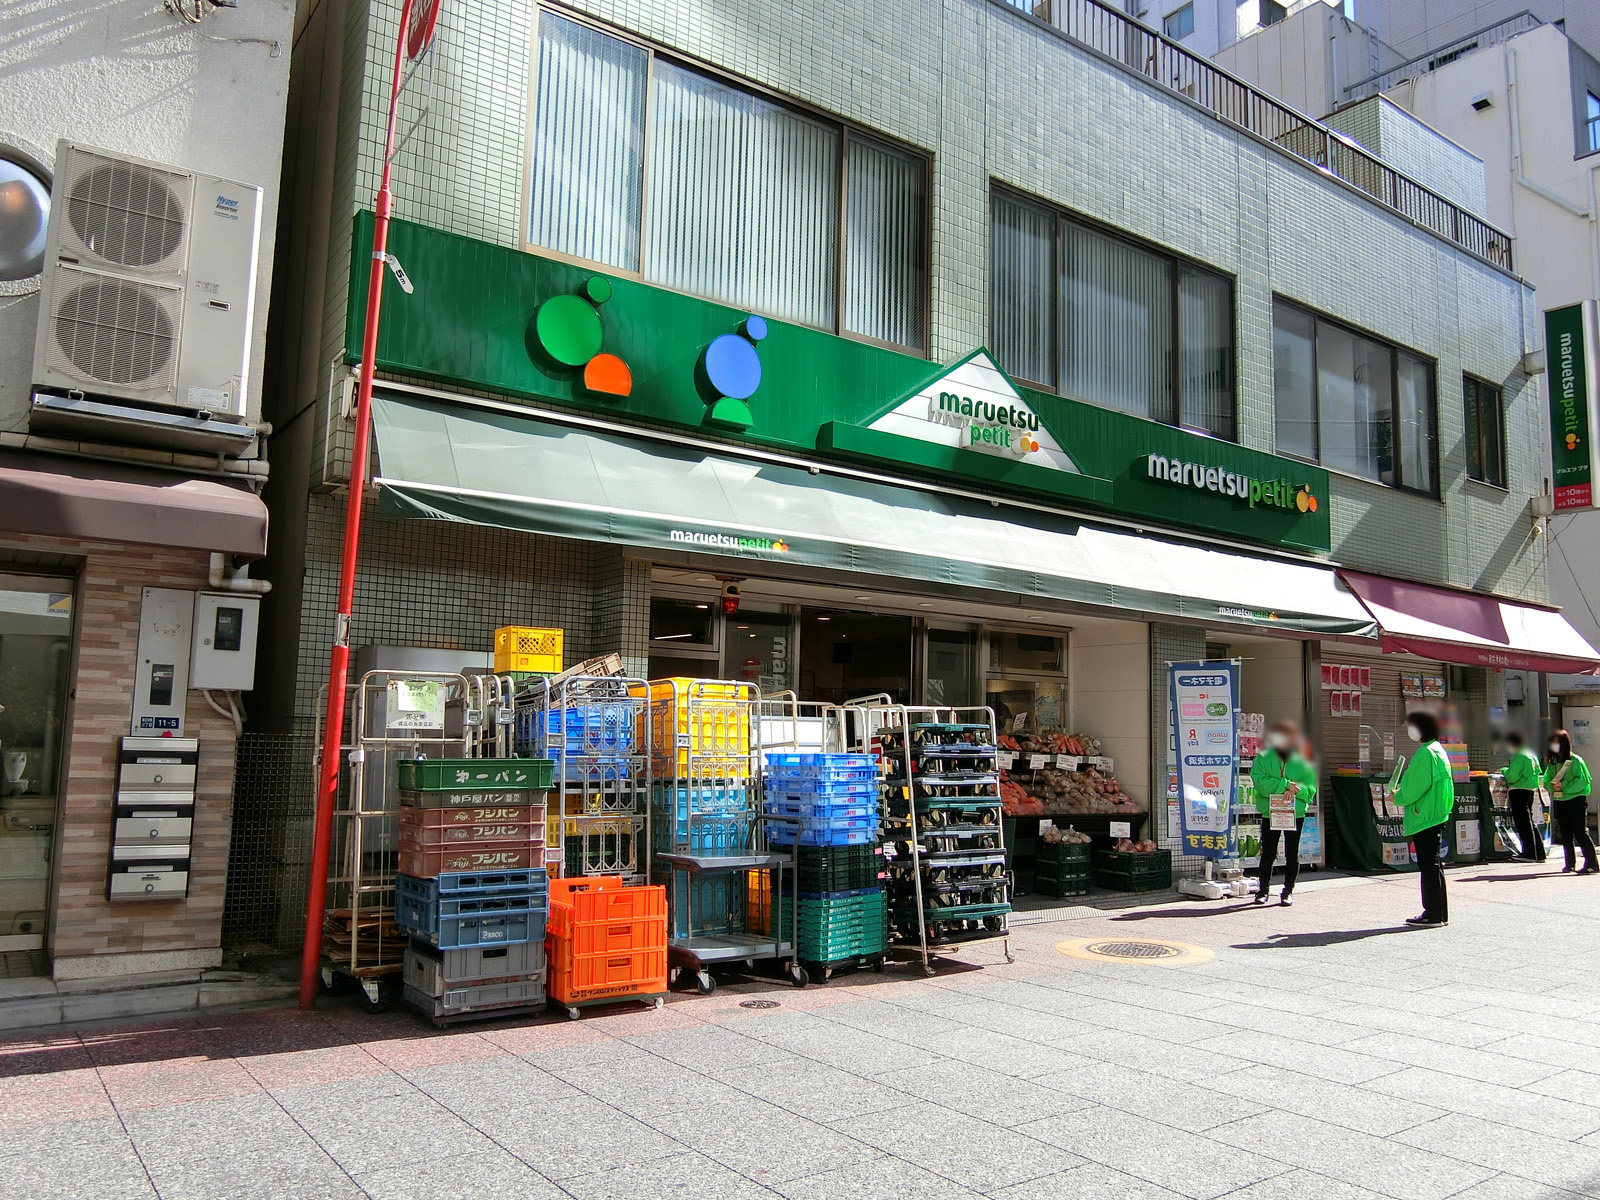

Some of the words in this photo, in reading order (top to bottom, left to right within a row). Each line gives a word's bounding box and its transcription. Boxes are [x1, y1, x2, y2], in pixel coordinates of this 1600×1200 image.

[216, 195, 239, 207] Hyper
[216, 203, 239, 213] Inverter
[939, 391, 1039, 432] maruetsu
[970, 425, 1011, 448] petit
[158, 719, 177, 727] 11-5
[473, 808, 520, 819] フジパン
[472, 826, 519, 836] フジパン
[471, 852, 520, 865] フジパン
[482, 930, 504, 940] Pasco
